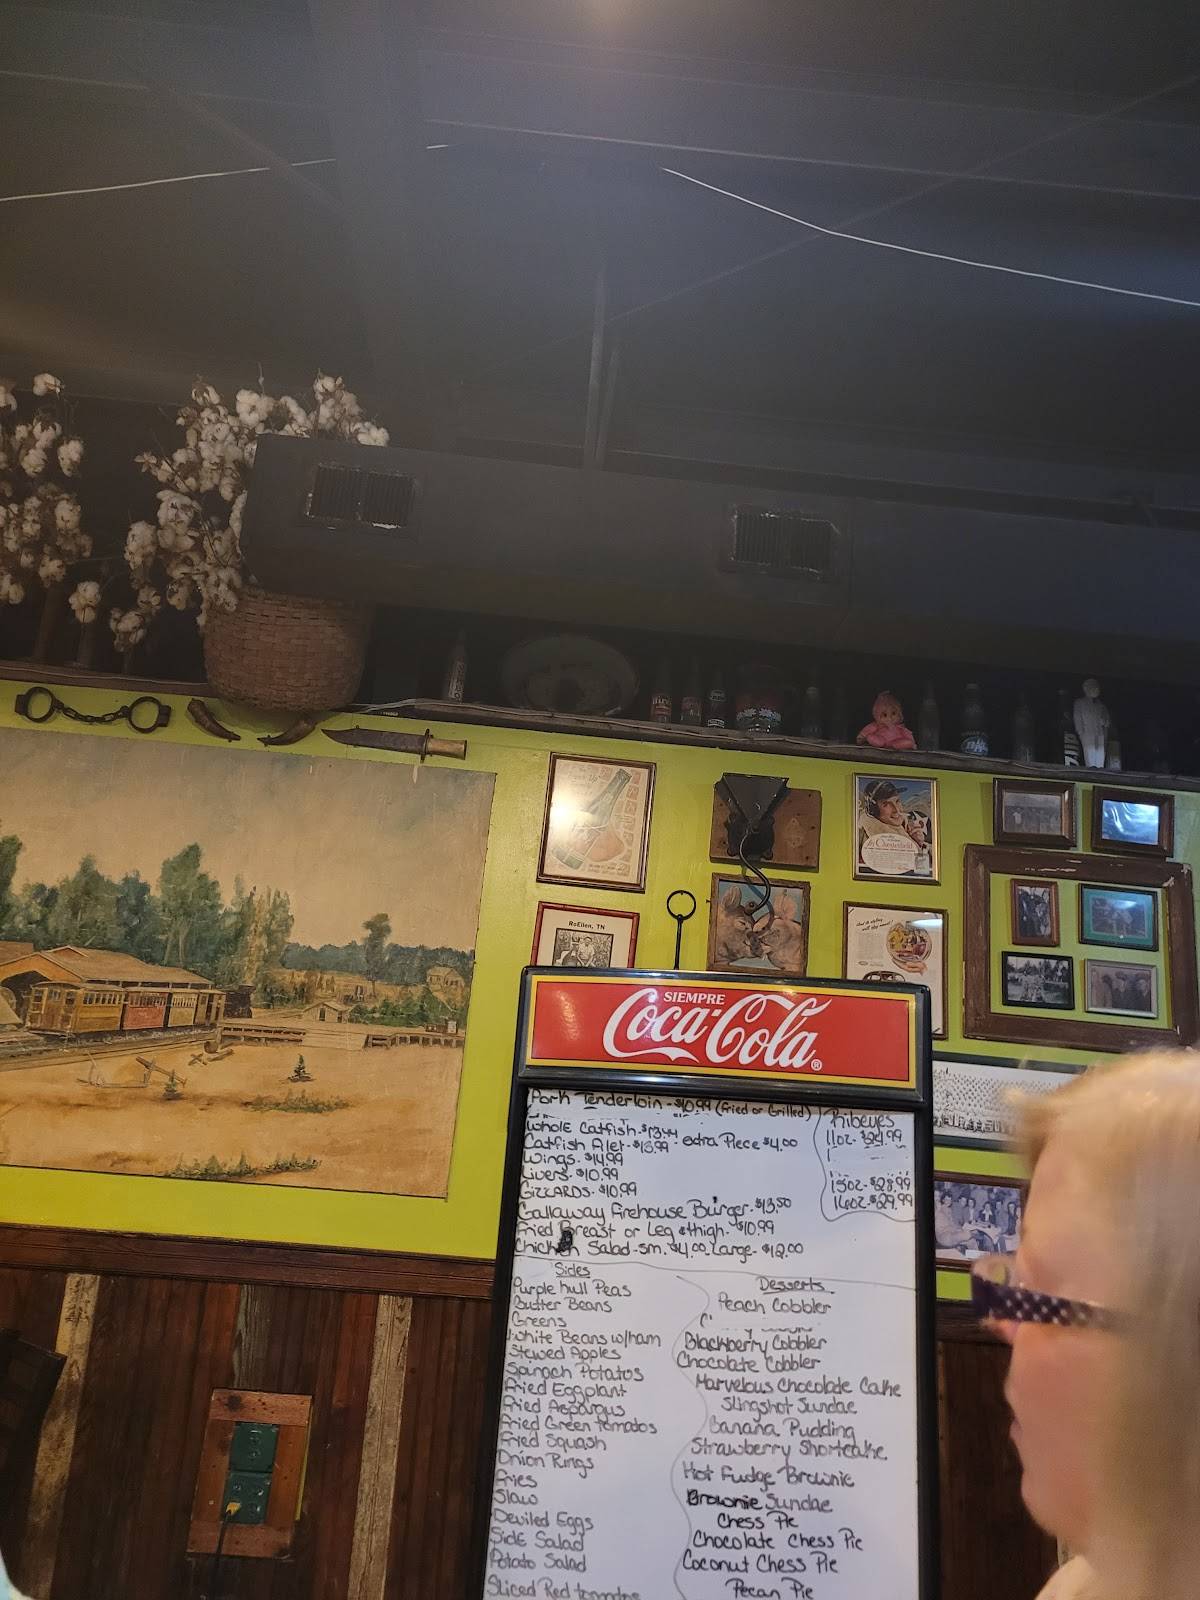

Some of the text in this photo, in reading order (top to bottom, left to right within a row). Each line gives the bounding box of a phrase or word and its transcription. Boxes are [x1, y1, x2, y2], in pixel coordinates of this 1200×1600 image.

[597, 923, 606, 931] TN
[663, 991, 725, 1006] SIEMPRE
[602, 987, 832, 1071] Coca-Cola
[531, 1088, 571, 1105] Pork
[574, 1090, 663, 1110] Tenderloin
[751, 1107, 763, 1116] or
[823, 1107, 895, 1131] Ribeyes
[523, 1132, 586, 1152] Catfish
[682, 1132, 719, 1148] extra
[763, 1136, 798, 1152] $4.00
[584, 1151, 624, 1168] $14.99
[576, 1167, 619, 1182] $10.99
[599, 1181, 637, 1199] $10.99
[624, 1228, 641, 1238] or
[648, 1221, 675, 1245] Leg
[761, 1242, 804, 1259] $12.00
[555, 1261, 591, 1277] Sides
[512, 1276, 556, 1298] Purple
[592, 1278, 632, 1298] Peas
[756, 1276, 826, 1292] Desserts
[514, 1295, 613, 1313] Butter Beans
[718, 1291, 832, 1315] Peach Cobbler
[511, 1311, 568, 1328] Greens
[556, 1328, 608, 1346] Beans
[611, 1330, 661, 1349] w/ham
[684, 1331, 828, 1358] Blackberry Cobbler
[508, 1344, 622, 1364] Stewed Apples
[676, 1351, 821, 1373] Chocolate Cobbler
[504, 1376, 628, 1405] Fried Eggplant
[696, 1373, 903, 1398] Marvelous Chocolate Cake
[502, 1395, 541, 1414] Fried
[720, 1395, 858, 1422] Slingshot Sundae
[500, 1413, 540, 1432] Fried
[545, 1415, 591, 1432] Green
[709, 1414, 854, 1445] Banana Pudding
[499, 1431, 607, 1452] Fried Squash
[690, 1437, 791, 1467] Strawberry
[498, 1449, 594, 1479] Onion Rings
[682, 1460, 714, 1482] Hot
[776, 1463, 855, 1488] Brownie
[495, 1468, 538, 1489] Fries
[493, 1488, 538, 1506] Slaw
[686, 1488, 833, 1513] Brownie Sundae
[492, 1507, 594, 1536] Deviled Eggs
[717, 1510, 799, 1530] Chess Pie
[535, 1530, 584, 1552] Salad
[692, 1527, 864, 1551] Chocolate Chess Pie
[488, 1548, 587, 1573] Potato Salad
[682, 1548, 839, 1574] Coconut Chess Pie
[486, 1574, 537, 1598] Sliced
[537, 1576, 571, 1600] Red
[725, 1576, 814, 1600] Pecan Pie
